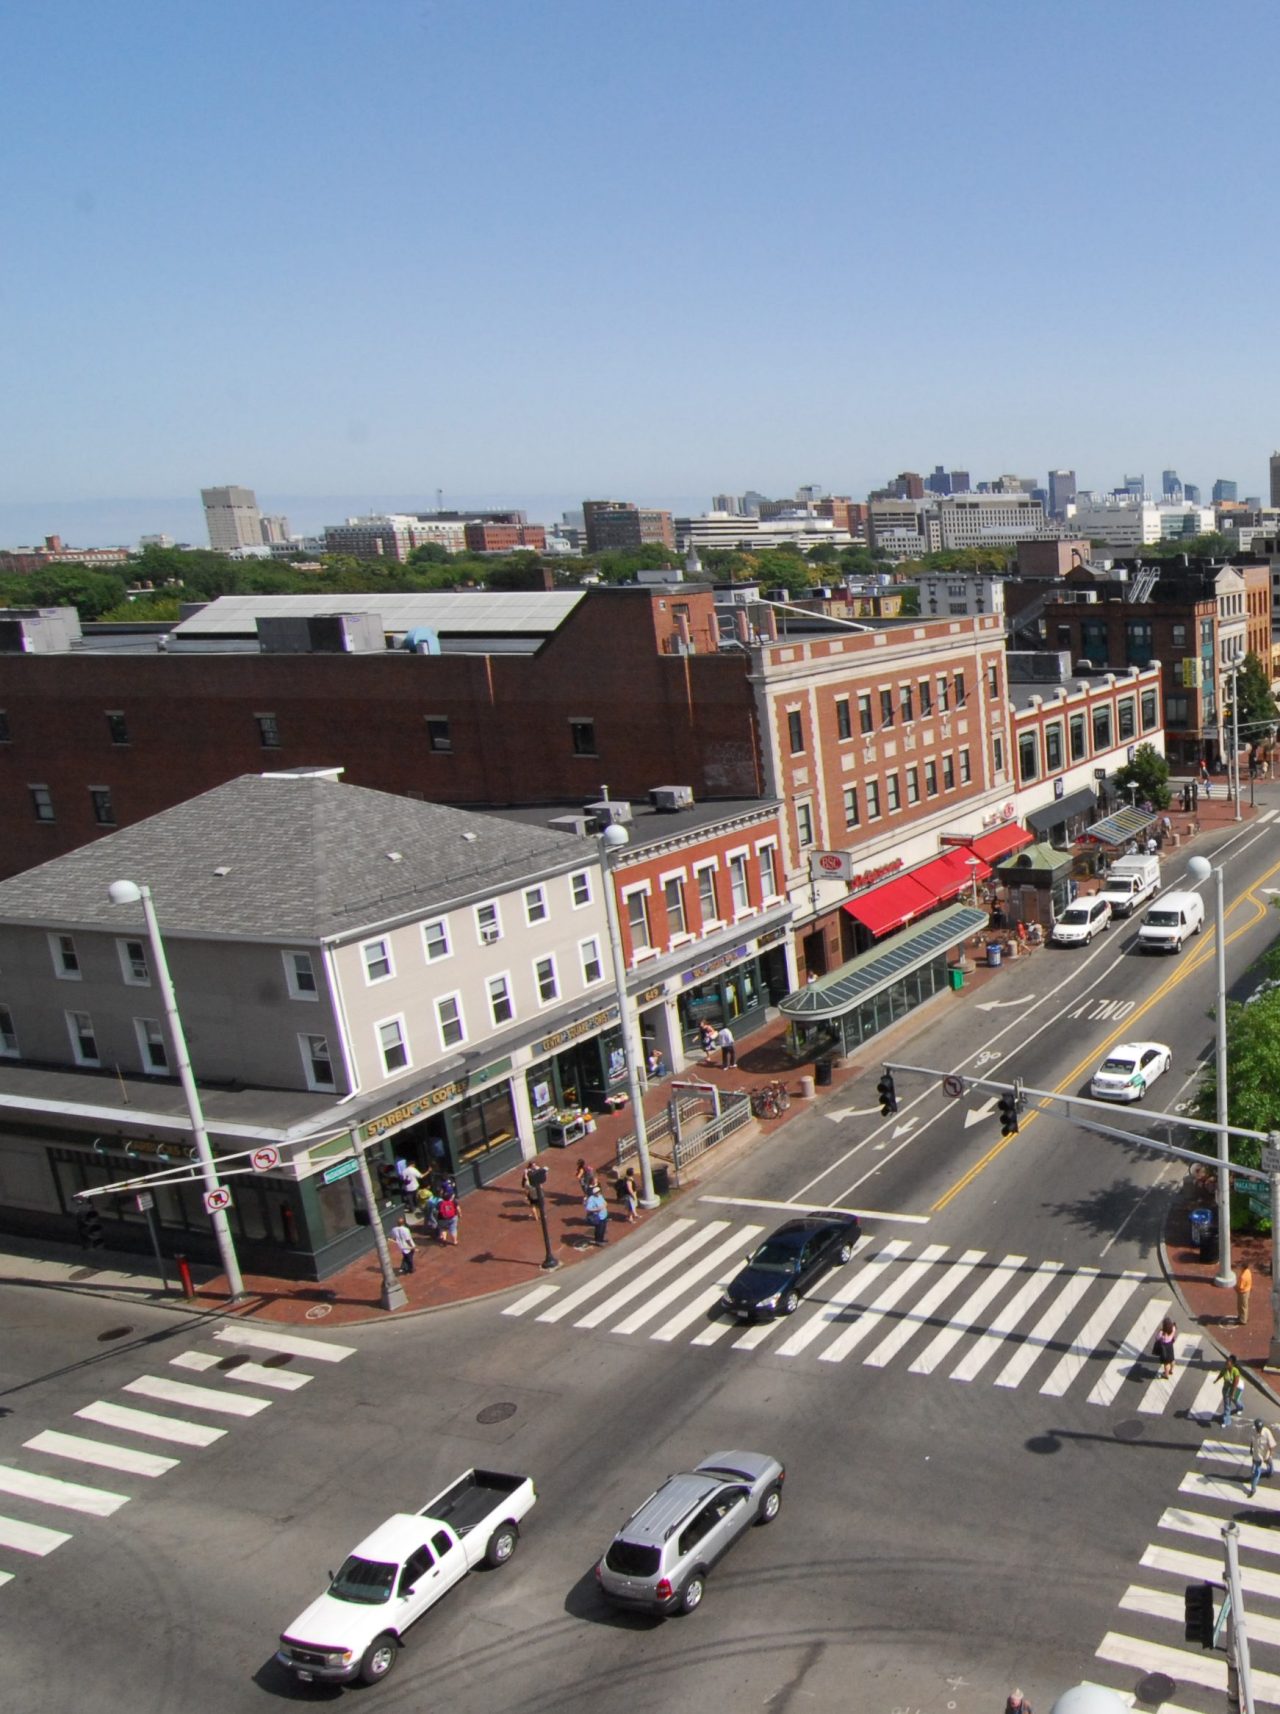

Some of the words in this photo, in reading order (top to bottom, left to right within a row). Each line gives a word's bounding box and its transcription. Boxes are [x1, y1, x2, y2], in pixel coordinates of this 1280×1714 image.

[822, 855, 840, 870] BSC
[645, 987, 659, 1003] 649
[1067, 998, 1136, 1021] ONLY
